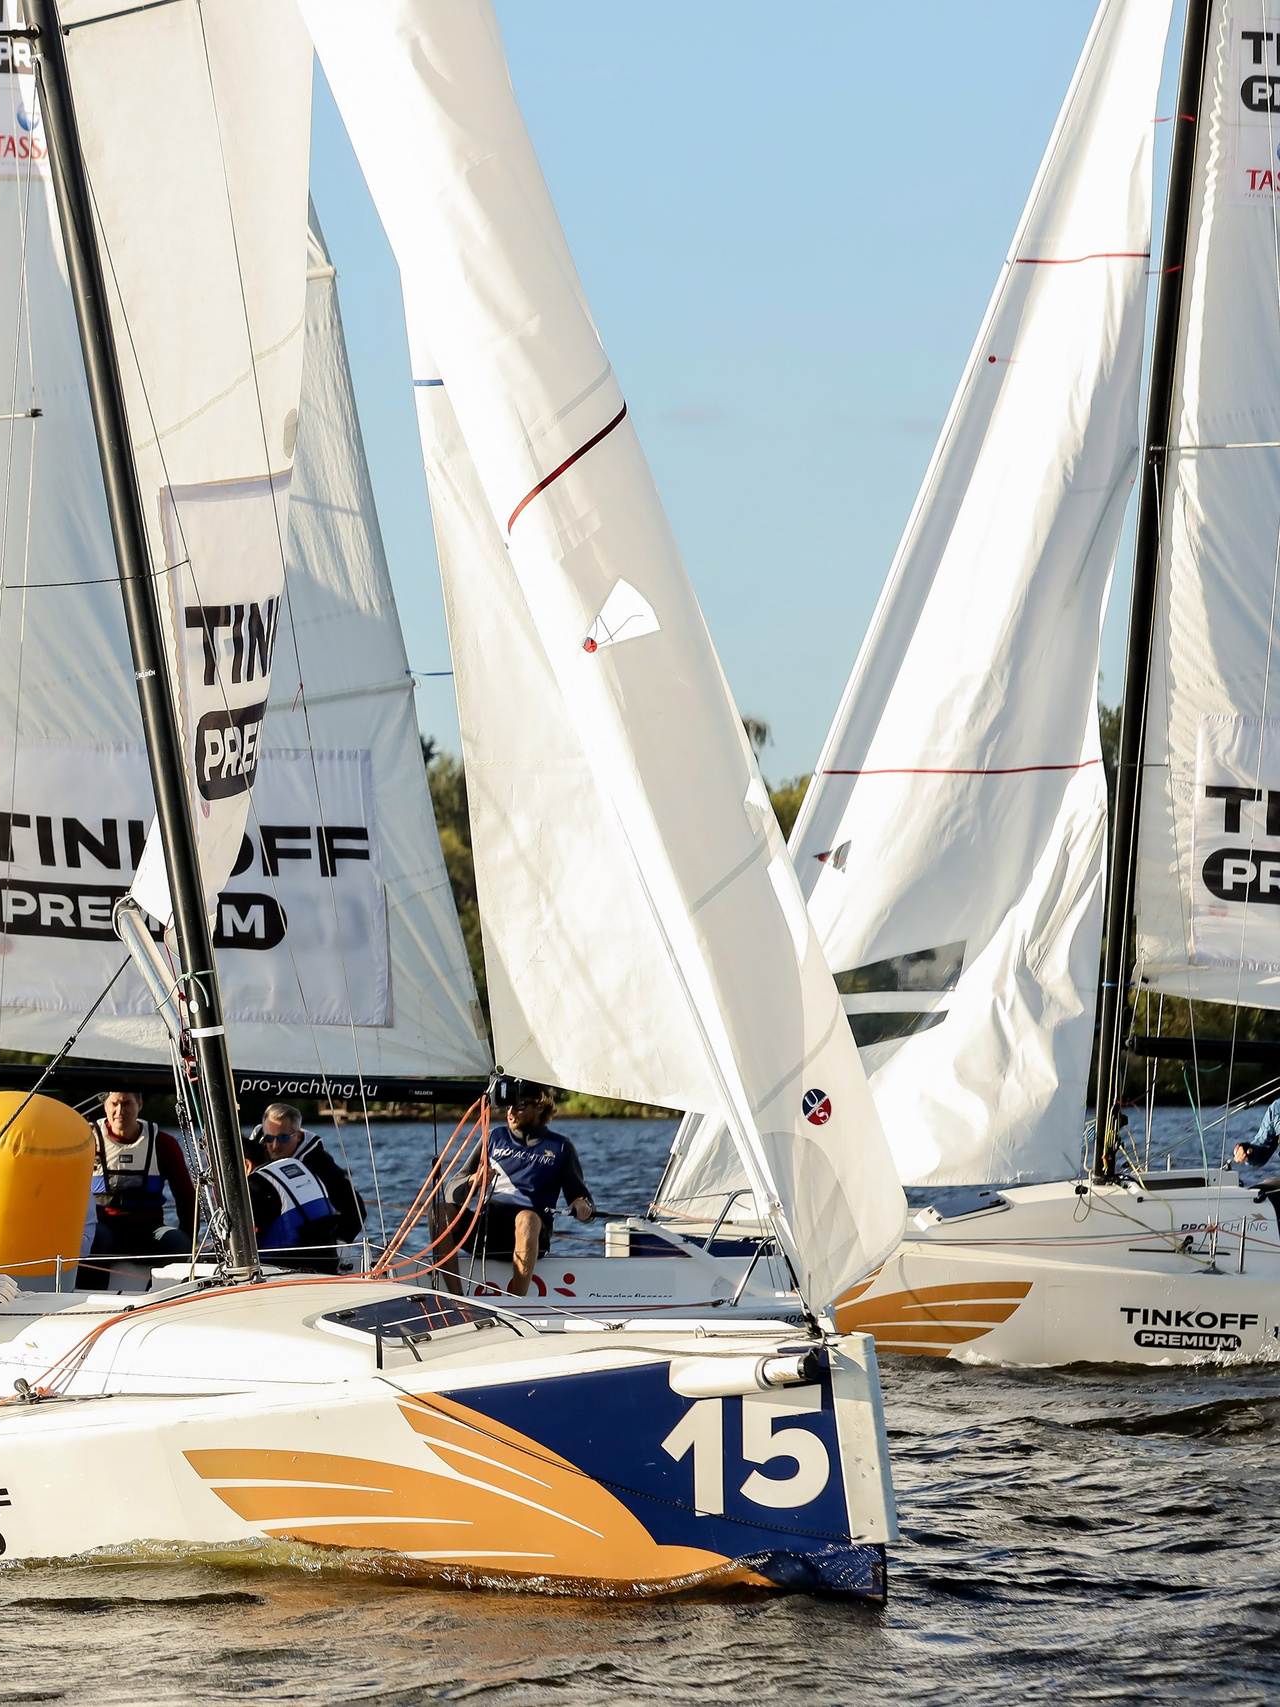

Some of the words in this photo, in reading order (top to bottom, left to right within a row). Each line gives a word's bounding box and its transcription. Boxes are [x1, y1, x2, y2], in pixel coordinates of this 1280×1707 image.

[240, 1078, 377, 1099] pro-yachting.ru
[1120, 1307, 1258, 1330] TINKOFF
[1140, 1332, 1235, 1349] PREMIUM
[661, 1384, 829, 1517] 15
